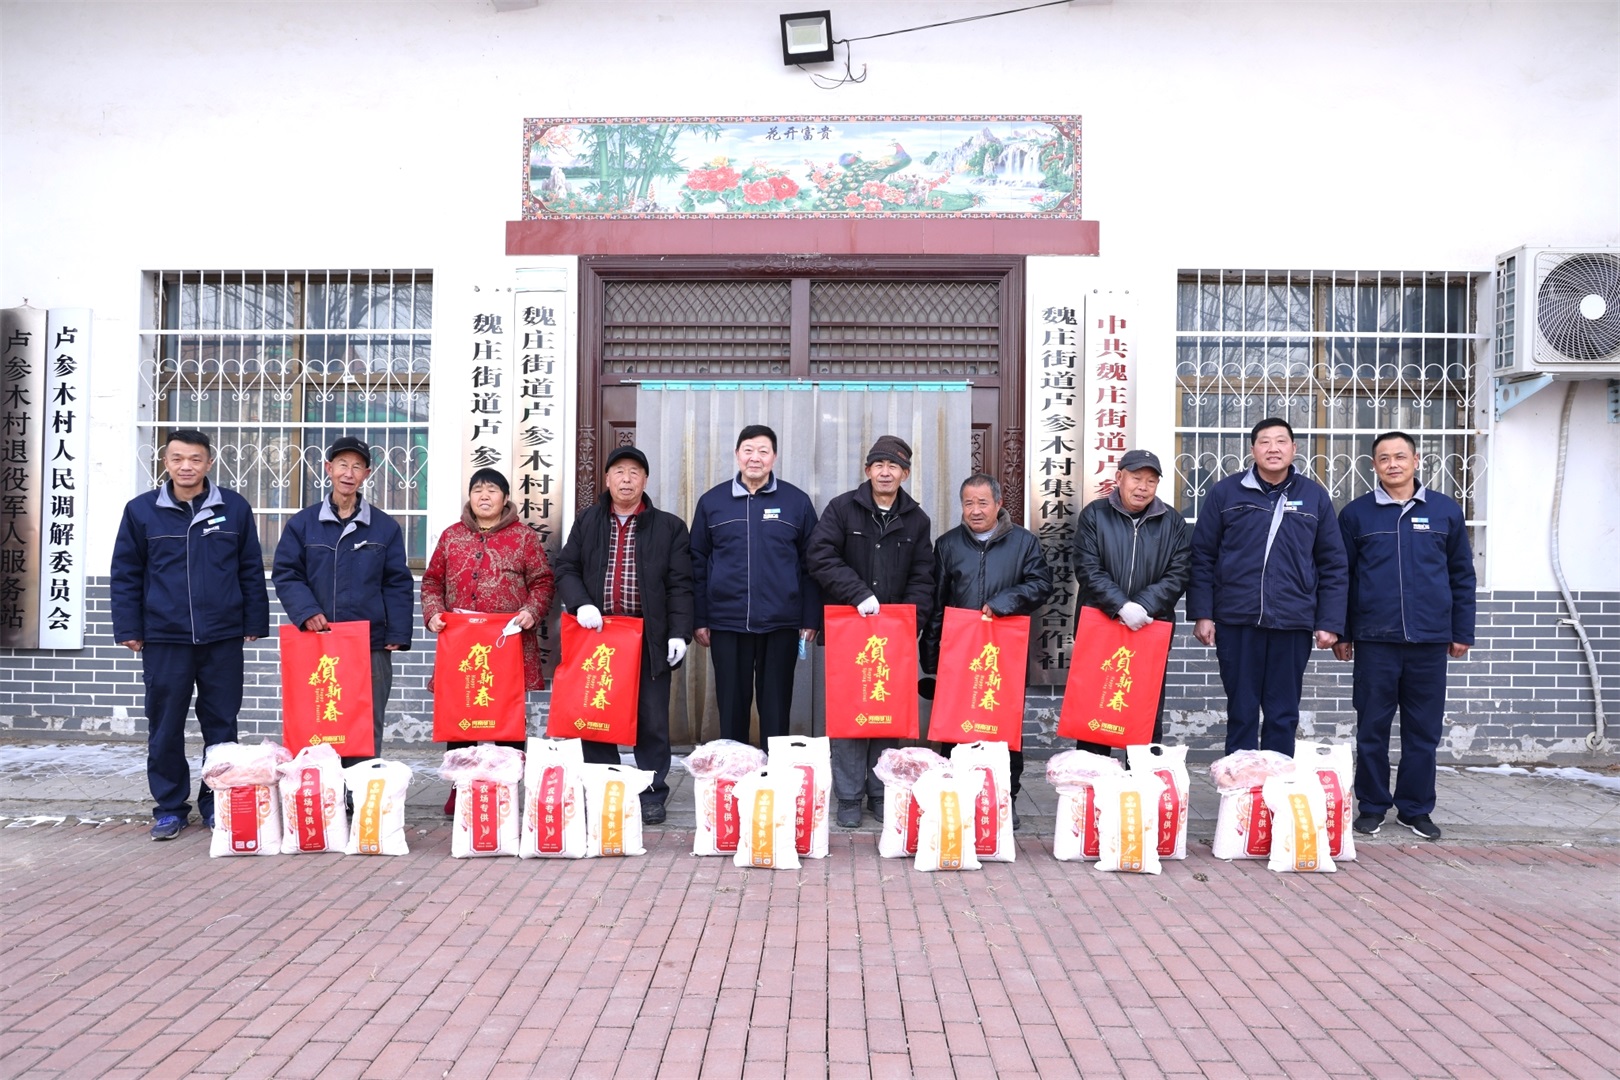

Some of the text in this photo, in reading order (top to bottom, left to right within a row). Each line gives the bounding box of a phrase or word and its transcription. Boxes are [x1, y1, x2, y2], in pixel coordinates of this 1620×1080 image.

[766, 125, 832, 140] 花开富贵
[470, 312, 503, 469] 魏庄街道卢参
[0, 329, 32, 630] 卢参木村退役军人服务站
[47, 326, 78, 631] 卢参木村人民调解委员会
[518, 306, 557, 664] 魏庄街道卢参木村村务
[1037, 306, 1078, 671] 魏庄街道卢参木村集体经济股份合作社
[303, 788, 314, 825] 农场专供
[479, 784, 489, 822] 农场专供
[545, 787, 555, 823] 农场专供
[724, 784, 733, 821] 农场专供
[796, 787, 806, 825] 农场专供
[981, 788, 990, 825] 农场专供
[1163, 793, 1173, 829] 农场专供
[1258, 794, 1267, 828] 场专供
[1325, 791, 1336, 828] 农场专供
